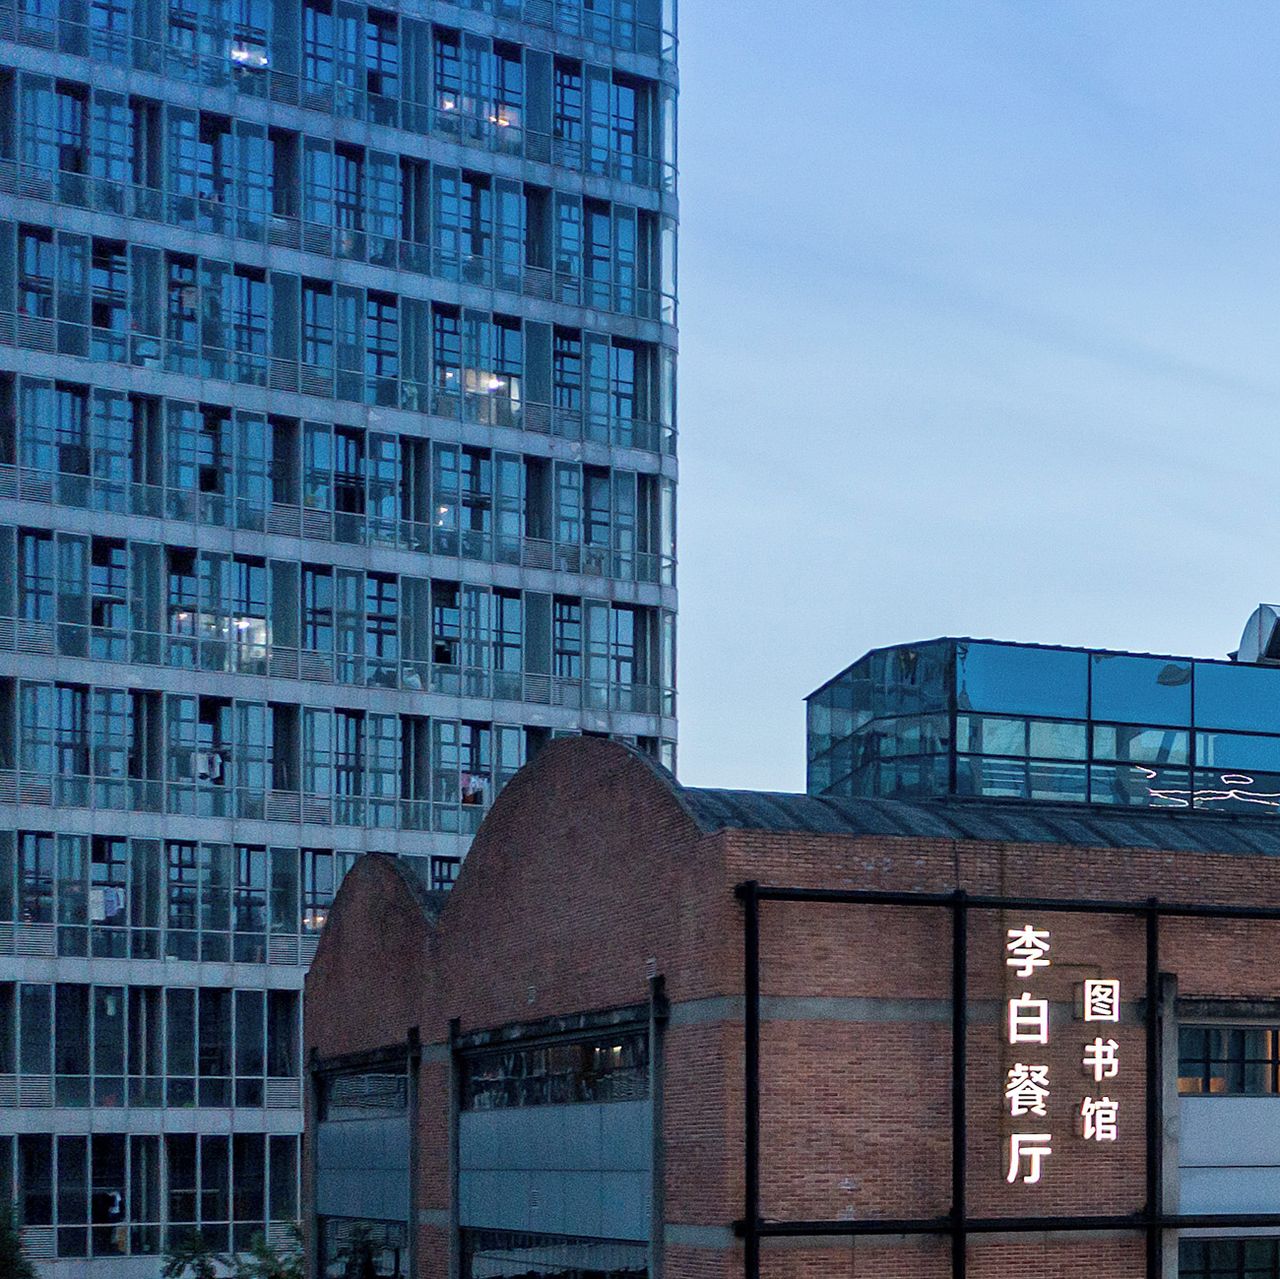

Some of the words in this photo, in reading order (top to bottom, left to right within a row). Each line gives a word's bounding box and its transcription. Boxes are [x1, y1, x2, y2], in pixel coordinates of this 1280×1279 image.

[1005, 925, 1052, 1183] 李白餐厅
[1080, 979, 1120, 1141] 图书馆
